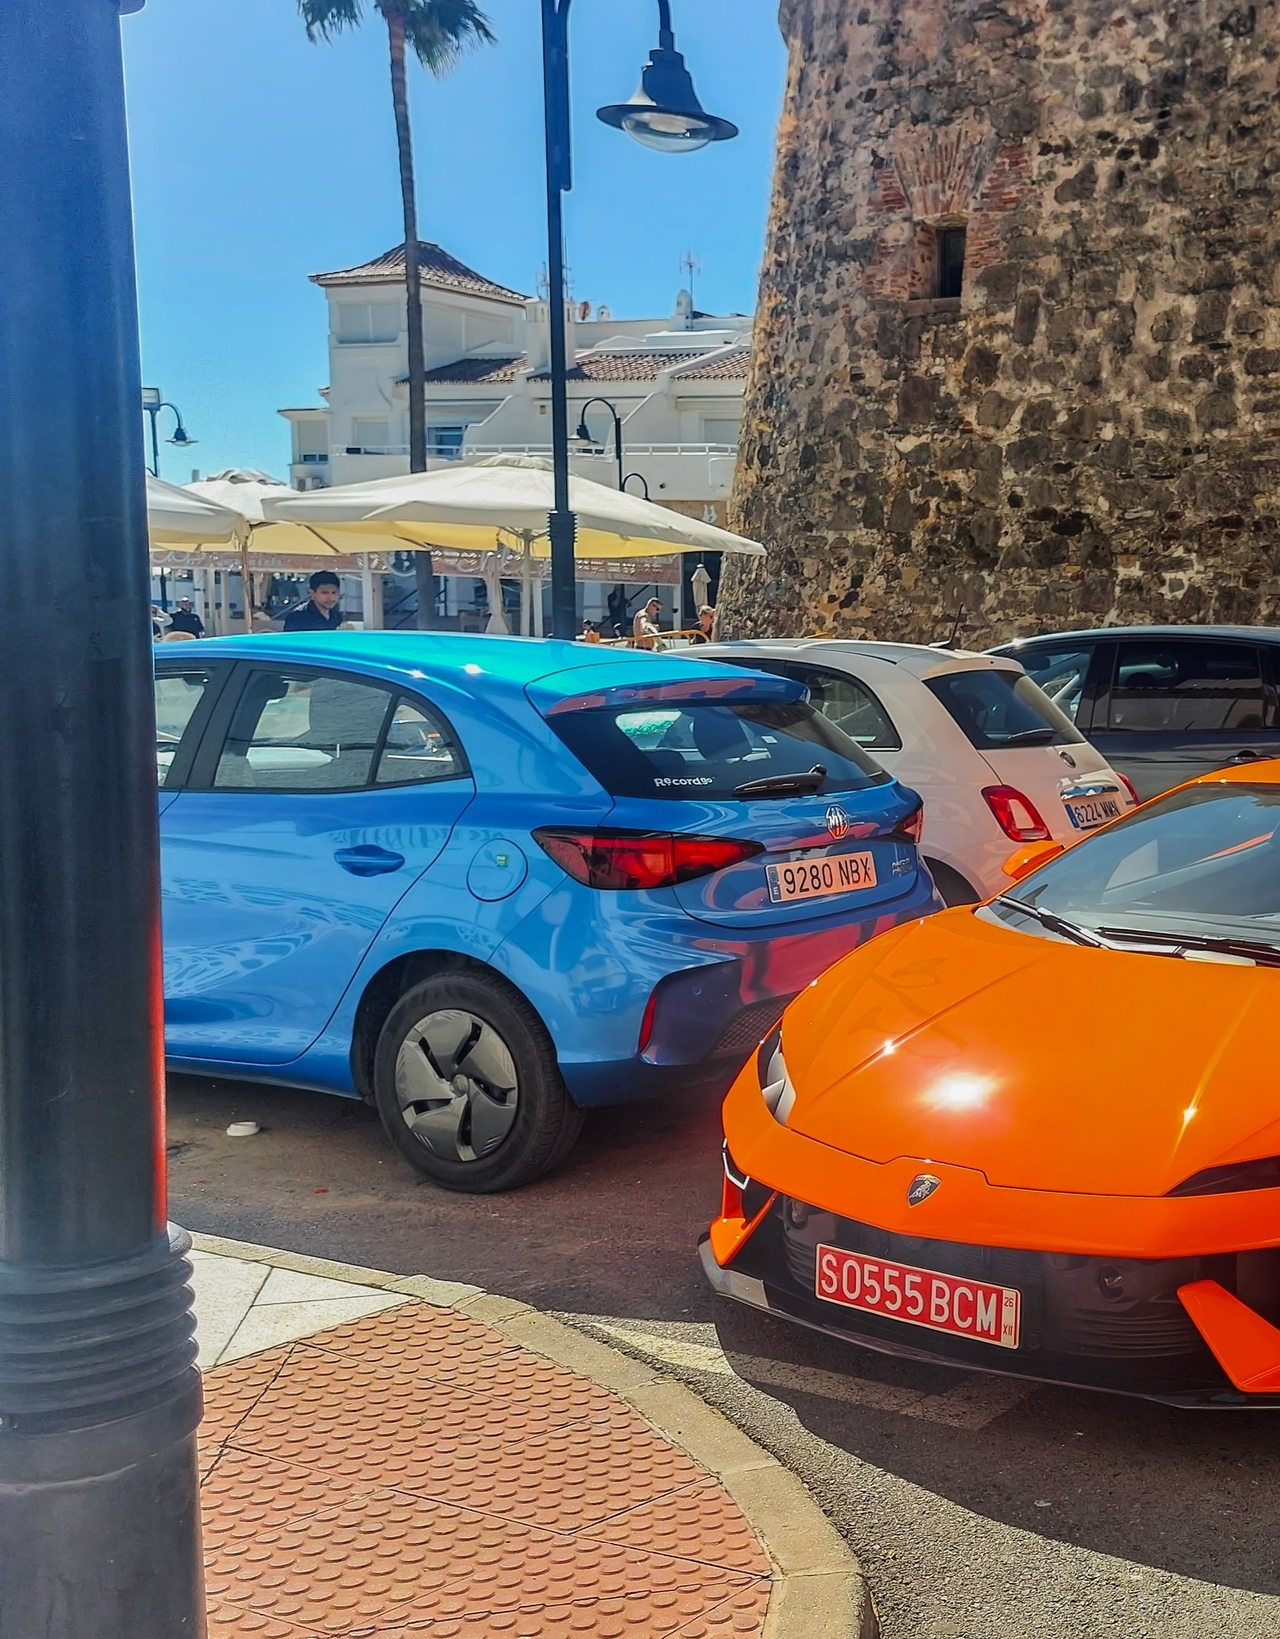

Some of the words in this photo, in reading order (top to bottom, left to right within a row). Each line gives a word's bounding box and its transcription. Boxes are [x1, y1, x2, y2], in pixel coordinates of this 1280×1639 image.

[1074, 803, 1102, 823] 6224
[783, 863, 834, 895] 9280
[837, 856, 872, 887] NBX
[1003, 1296, 1014, 1308] 26
